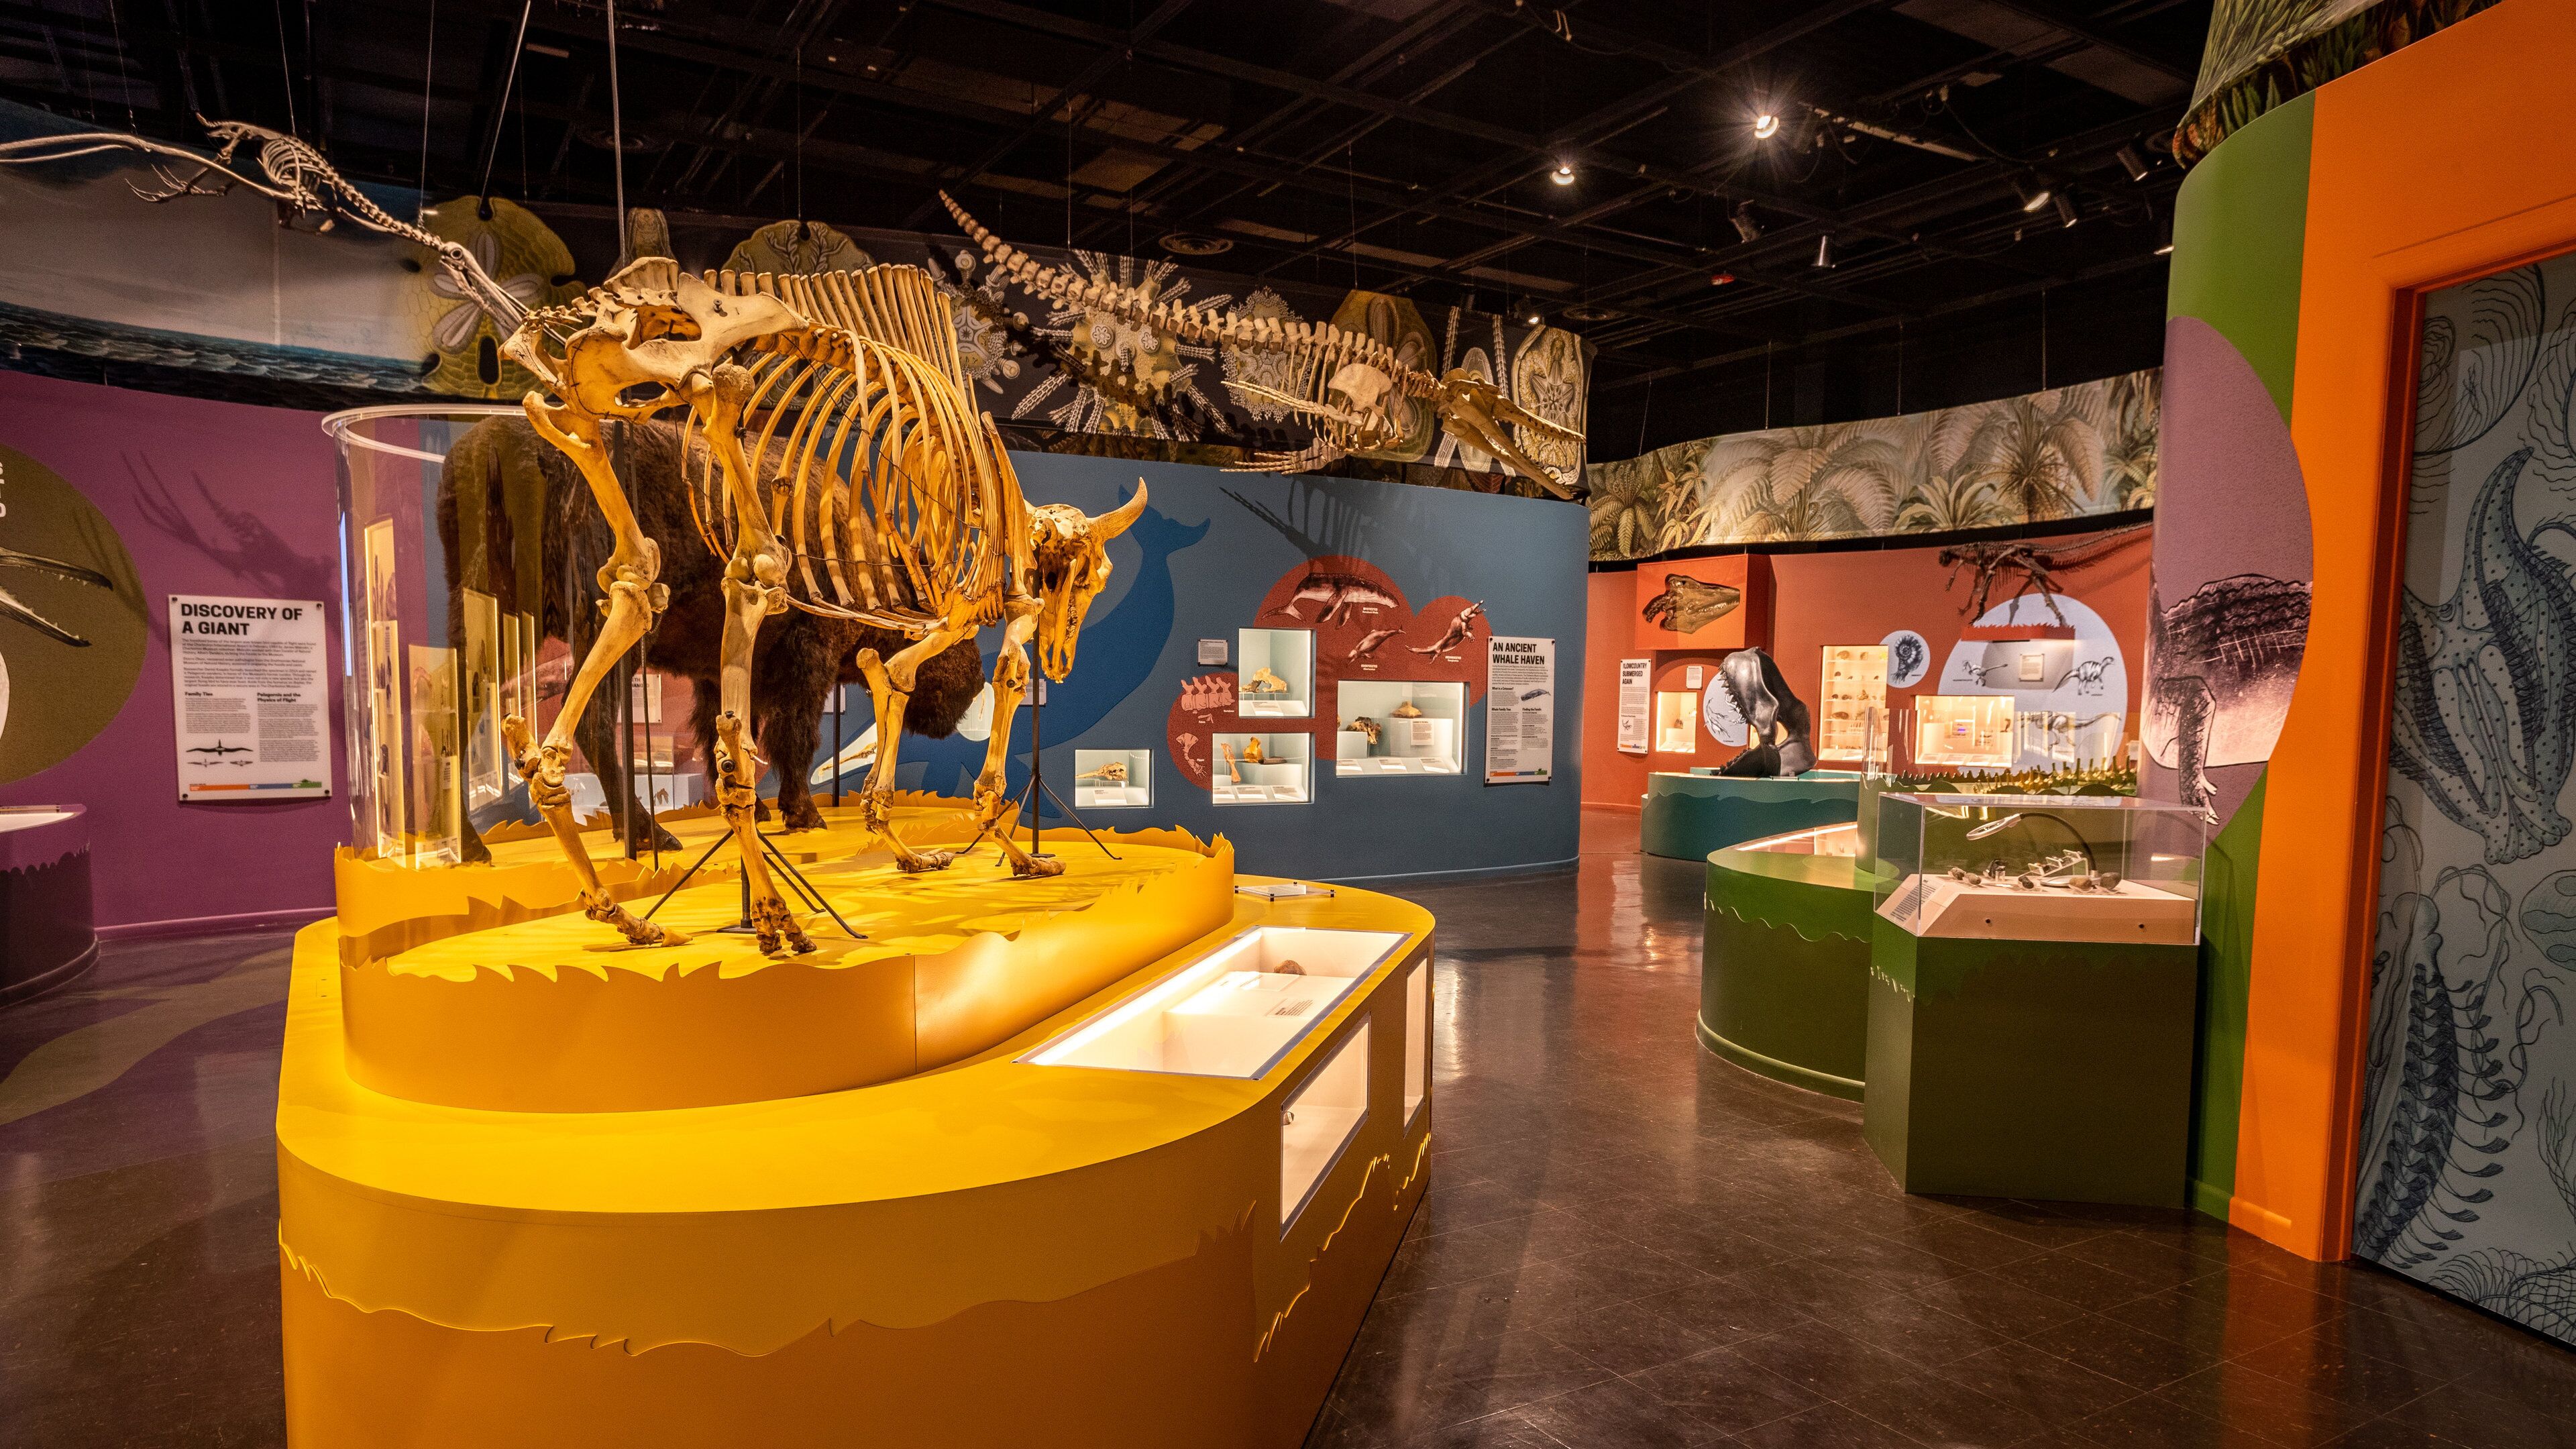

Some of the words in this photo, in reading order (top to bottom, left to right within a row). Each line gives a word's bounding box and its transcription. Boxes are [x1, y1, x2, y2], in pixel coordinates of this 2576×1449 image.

[181, 604, 277, 620] DISCOVERY
[282, 608, 303, 621] OF
[182, 621, 193, 634] A
[199, 622, 250, 635] GIANT
[1493, 642, 1503, 651] AN
[1505, 643, 1536, 653] ANCIENT
[1493, 654, 1519, 664] WHALE
[1521, 655, 1544, 664] HAVEN
